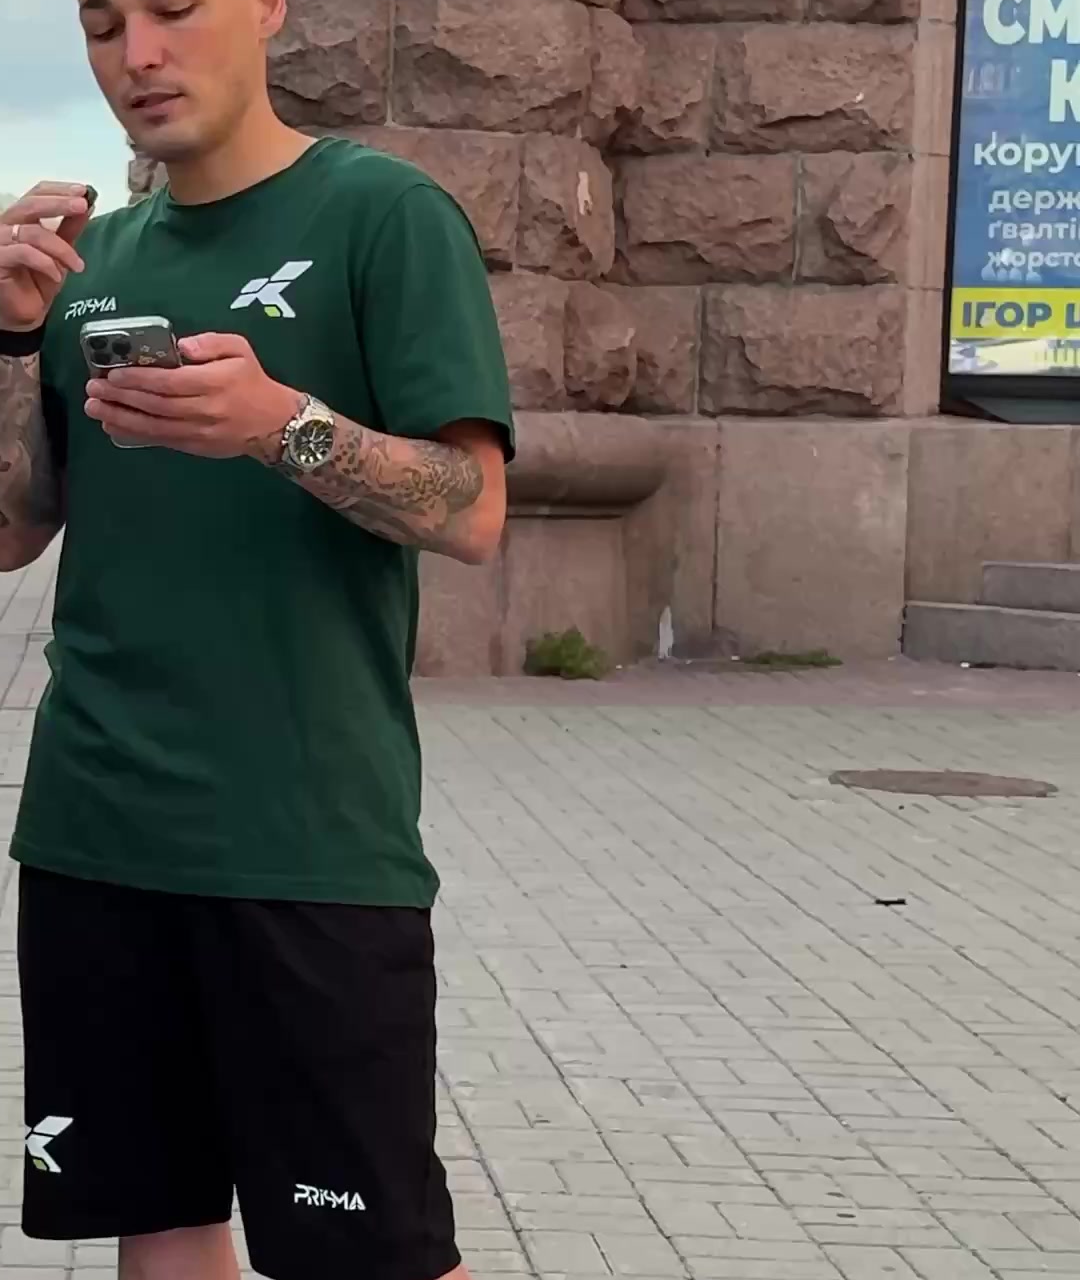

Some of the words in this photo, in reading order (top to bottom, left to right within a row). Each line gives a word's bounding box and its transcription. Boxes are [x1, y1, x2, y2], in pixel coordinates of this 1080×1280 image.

[974, 142, 1080, 174] кору
[988, 217, 1080, 239] ґвалті
[962, 302, 1052, 329] ІГОР
[293, 1183, 367, 1211] PRISMA
